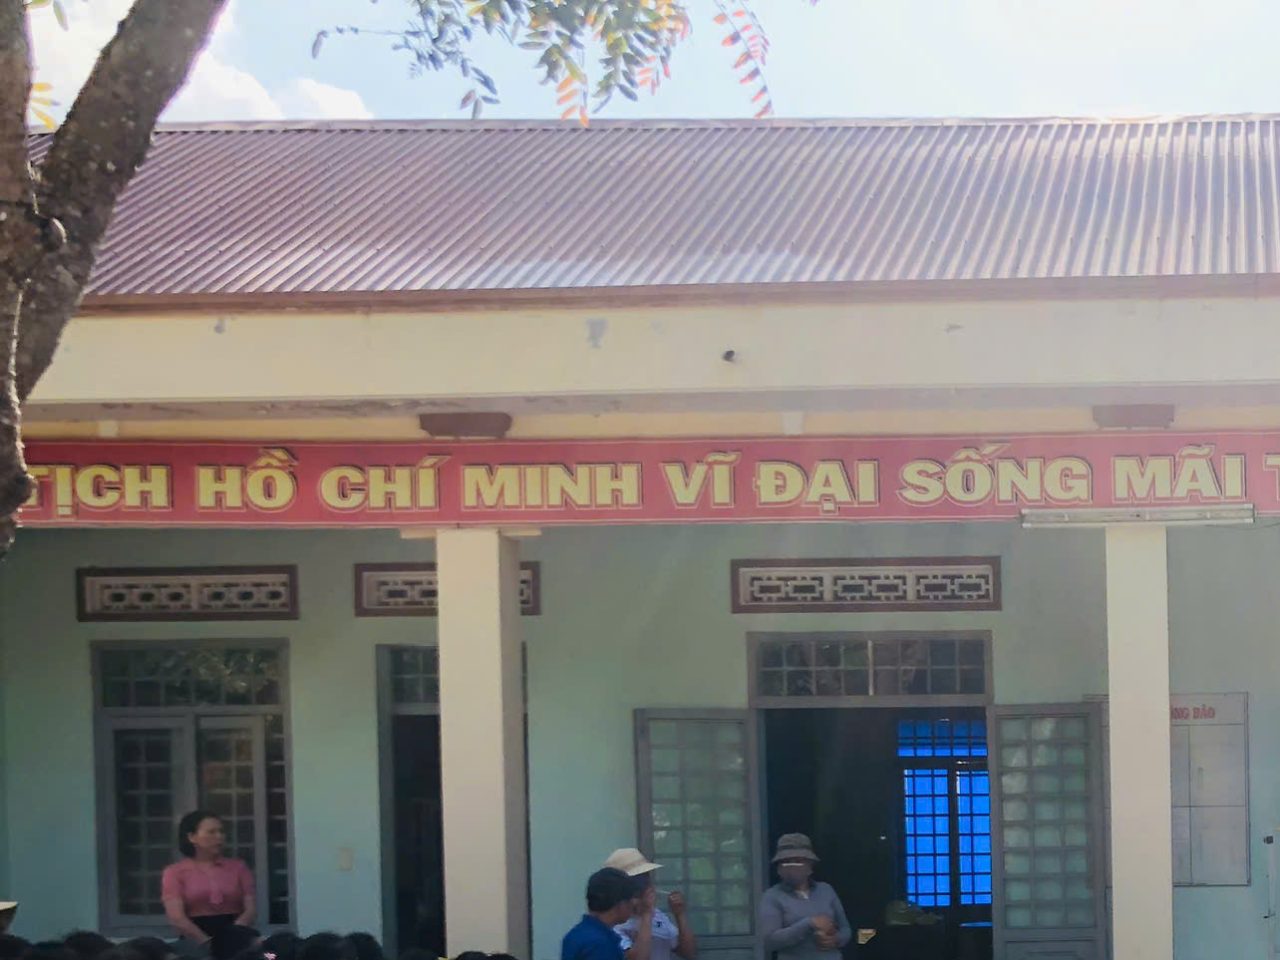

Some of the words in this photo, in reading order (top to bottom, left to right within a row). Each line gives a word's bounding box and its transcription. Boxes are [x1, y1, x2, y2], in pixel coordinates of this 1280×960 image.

[199, 449, 297, 508] HỒ
[321, 455, 448, 508] CHÍ
[462, 464, 644, 508] MINH
[667, 452, 738, 505] VĨ
[755, 458, 878, 513] ĐẠI
[899, 443, 1094, 504] SỐNG
[1112, 446, 1246, 500] MÃI
